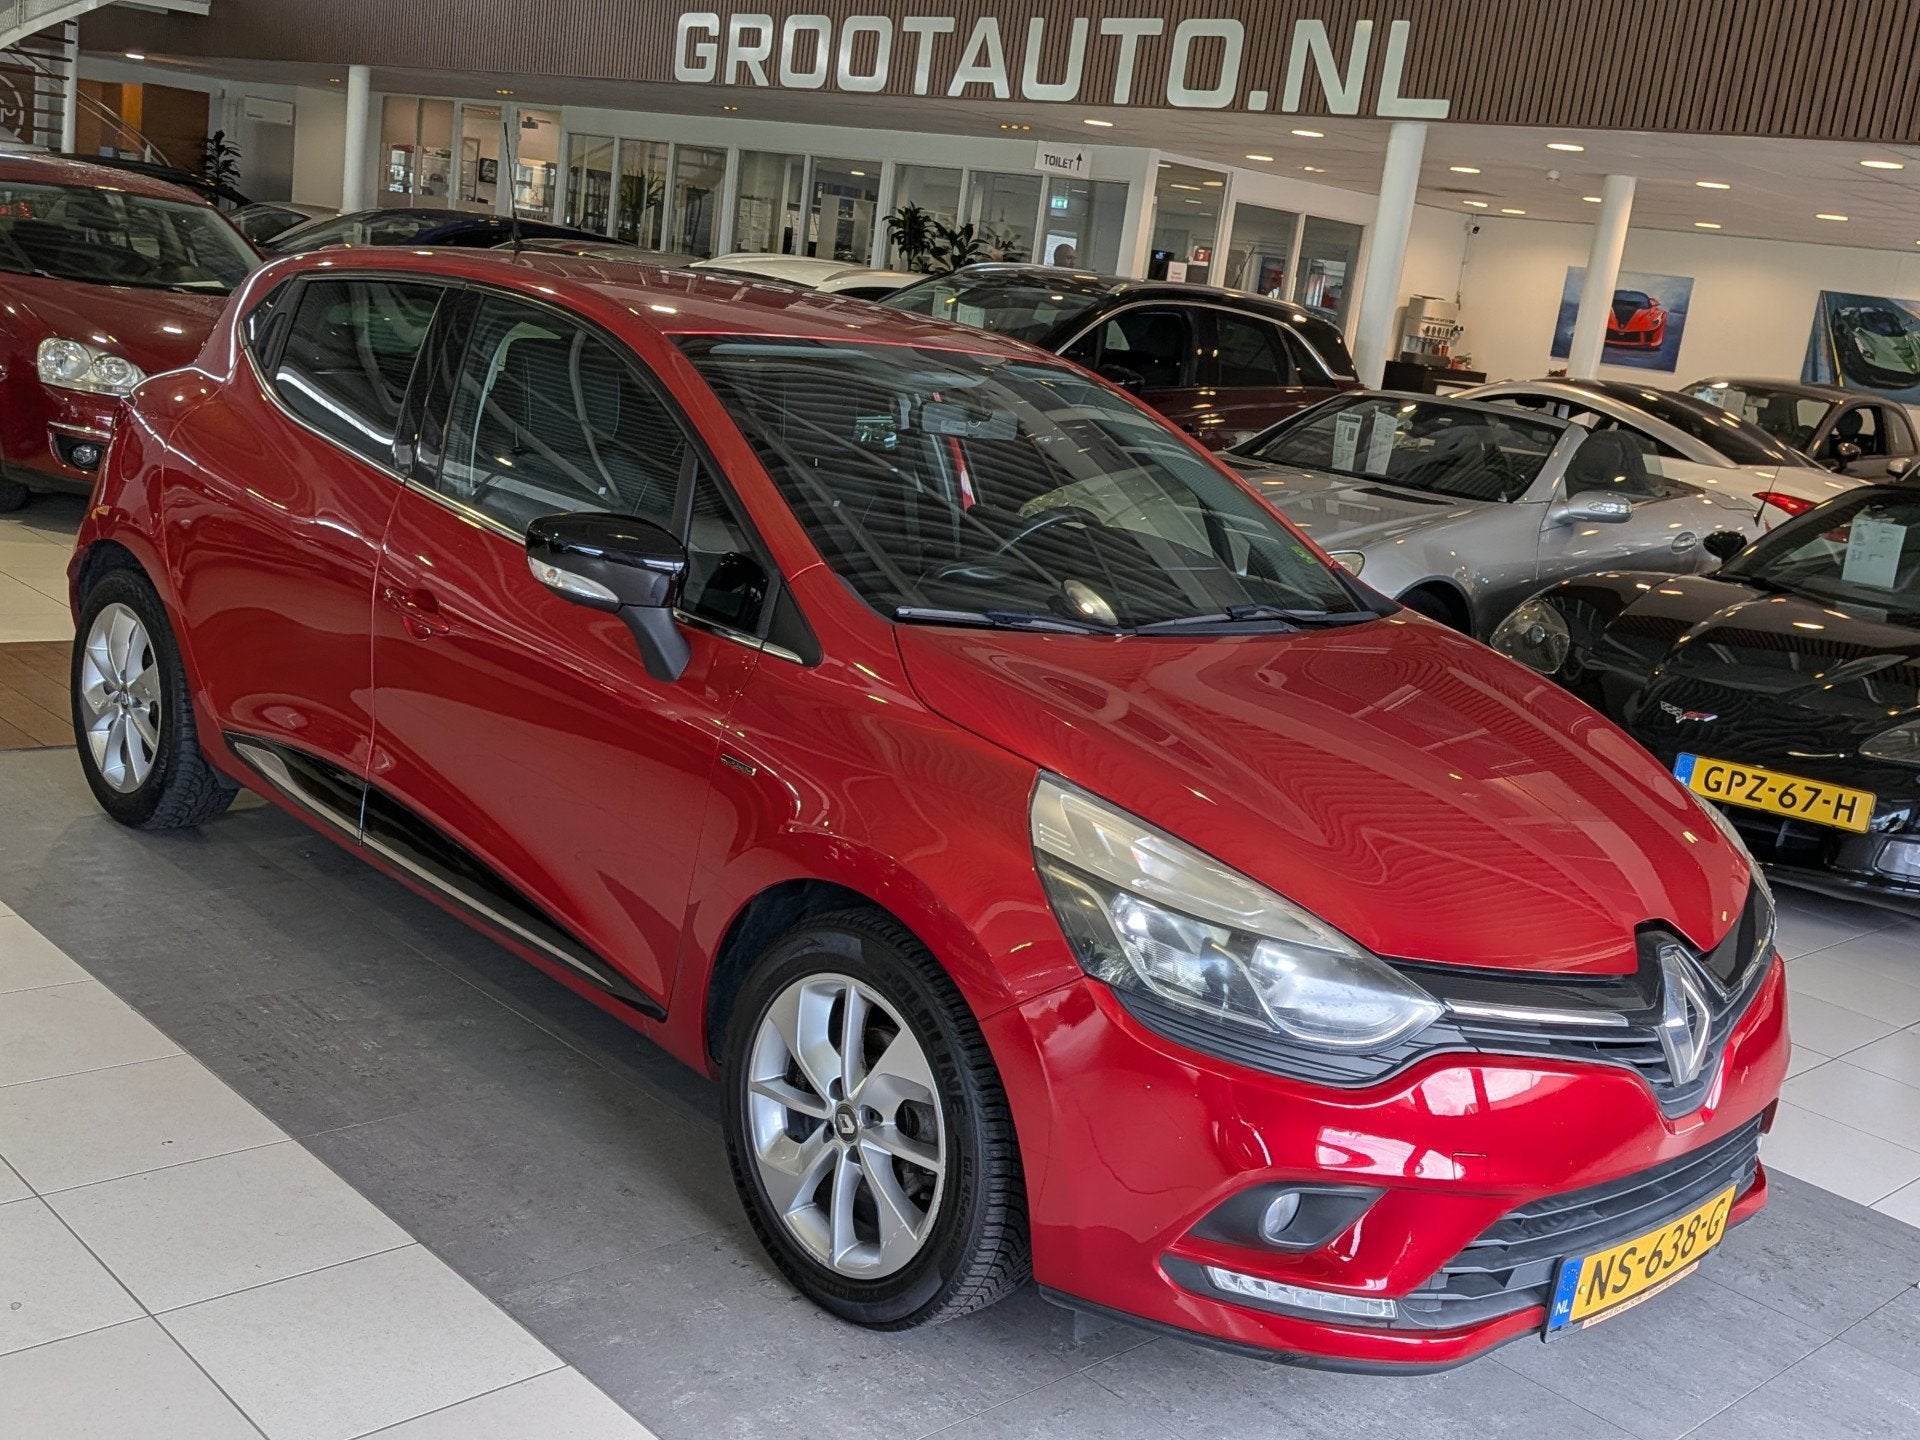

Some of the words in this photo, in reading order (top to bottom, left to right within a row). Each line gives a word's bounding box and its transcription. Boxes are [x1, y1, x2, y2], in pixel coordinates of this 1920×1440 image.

[674, 12, 1450, 119] GROOTAUTO.NL
[1044, 154, 1074, 169] TOILET
[1704, 766, 1858, 823] GPZ-67-H
[1585, 1198, 1727, 1307] NS-638-G
[1554, 1299, 1570, 1316] NL
